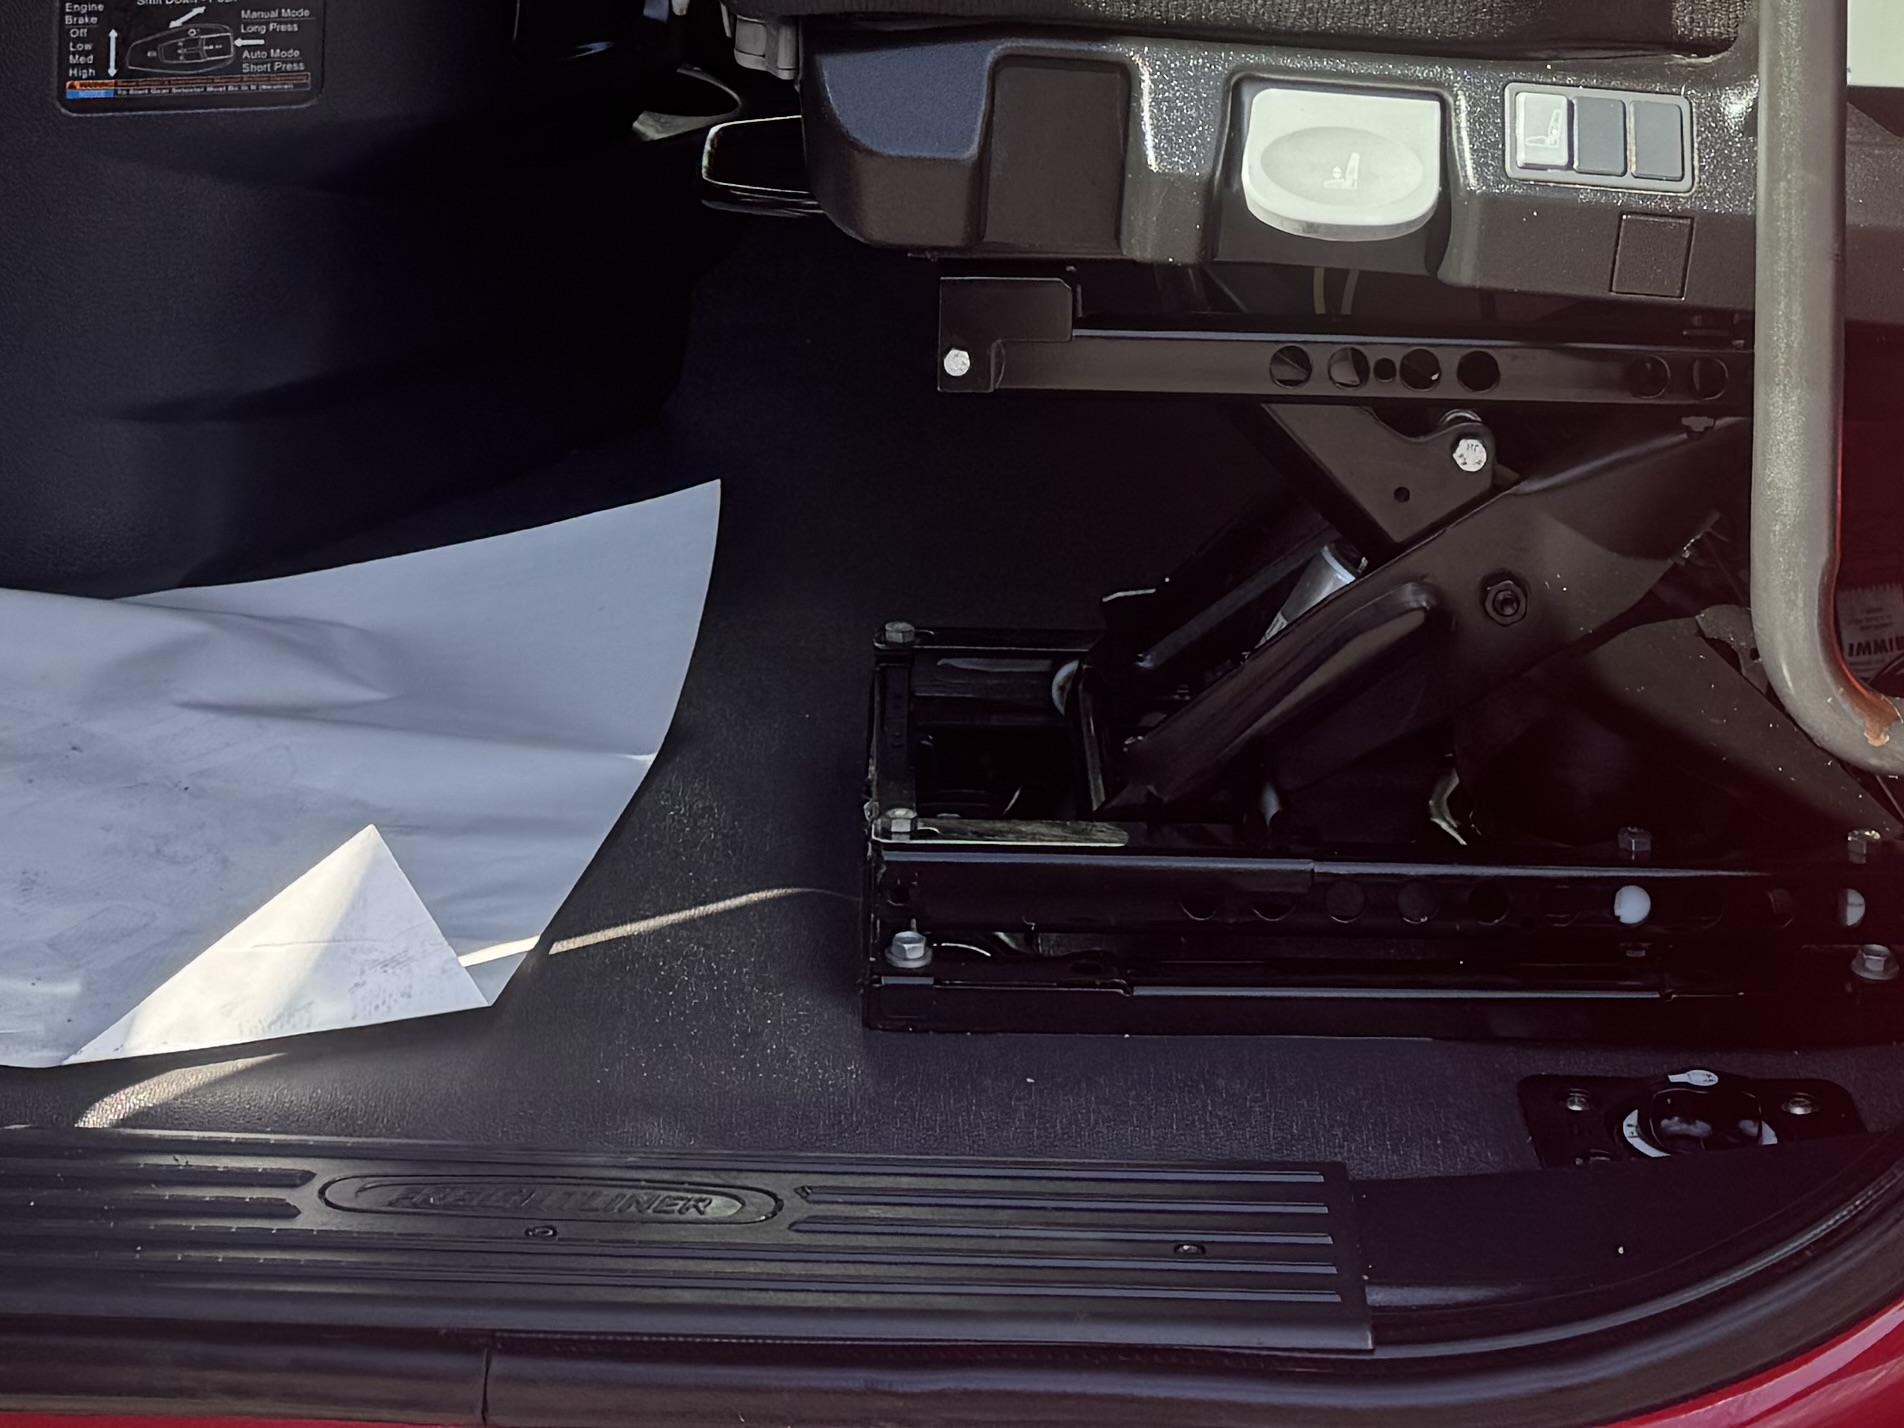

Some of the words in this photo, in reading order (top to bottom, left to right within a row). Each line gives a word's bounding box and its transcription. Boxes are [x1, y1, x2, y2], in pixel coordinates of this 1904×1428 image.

[65, 2, 105, 14] Engine
[241, 9, 279, 19] Manual
[281, 8, 311, 17] Mode
[65, 15, 98, 25] Brake
[69, 28, 88, 38] Off
[240, 23, 267, 34] Long
[269, 22, 299, 32] Press
[69, 42, 93, 51] Low
[69, 54, 94, 64] Med
[242, 49, 268, 59] Auto
[270, 48, 300, 58] Mode
[242, 63, 271, 73] Short
[274, 62, 305, 71] Press
[69, 68, 96, 79] High
